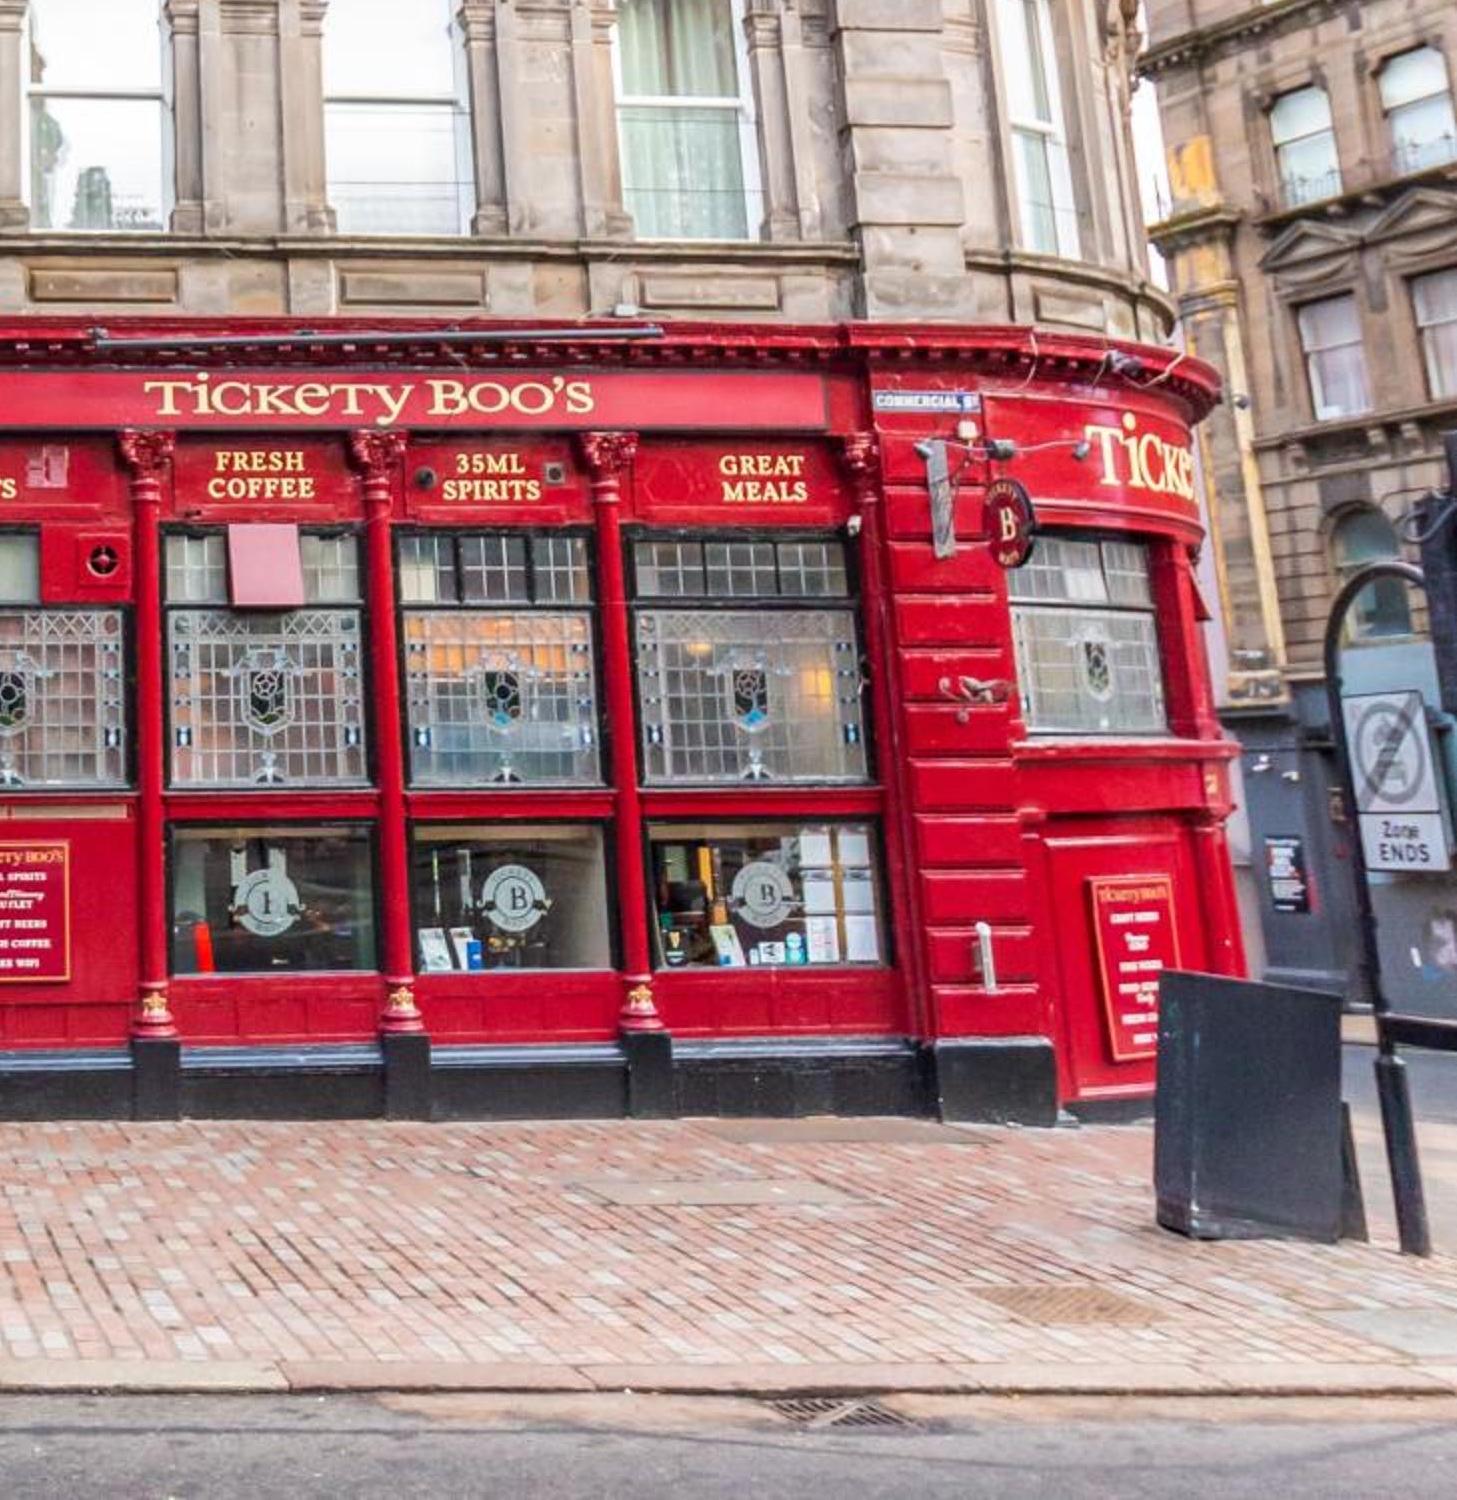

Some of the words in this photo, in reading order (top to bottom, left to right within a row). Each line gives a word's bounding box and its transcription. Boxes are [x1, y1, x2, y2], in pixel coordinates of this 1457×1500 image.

[214, 451, 306, 471] FRESH
[456, 452, 527, 474] 35ML
[718, 454, 805, 476] GREAT
[207, 477, 316, 499] COFFEE
[442, 479, 542, 501] SPIRITS
[721, 480, 808, 502] MEALS
[999, 506, 1017, 542] B
[1381, 820, 1420, 839] Zone
[1379, 843, 1431, 863] ENDS
